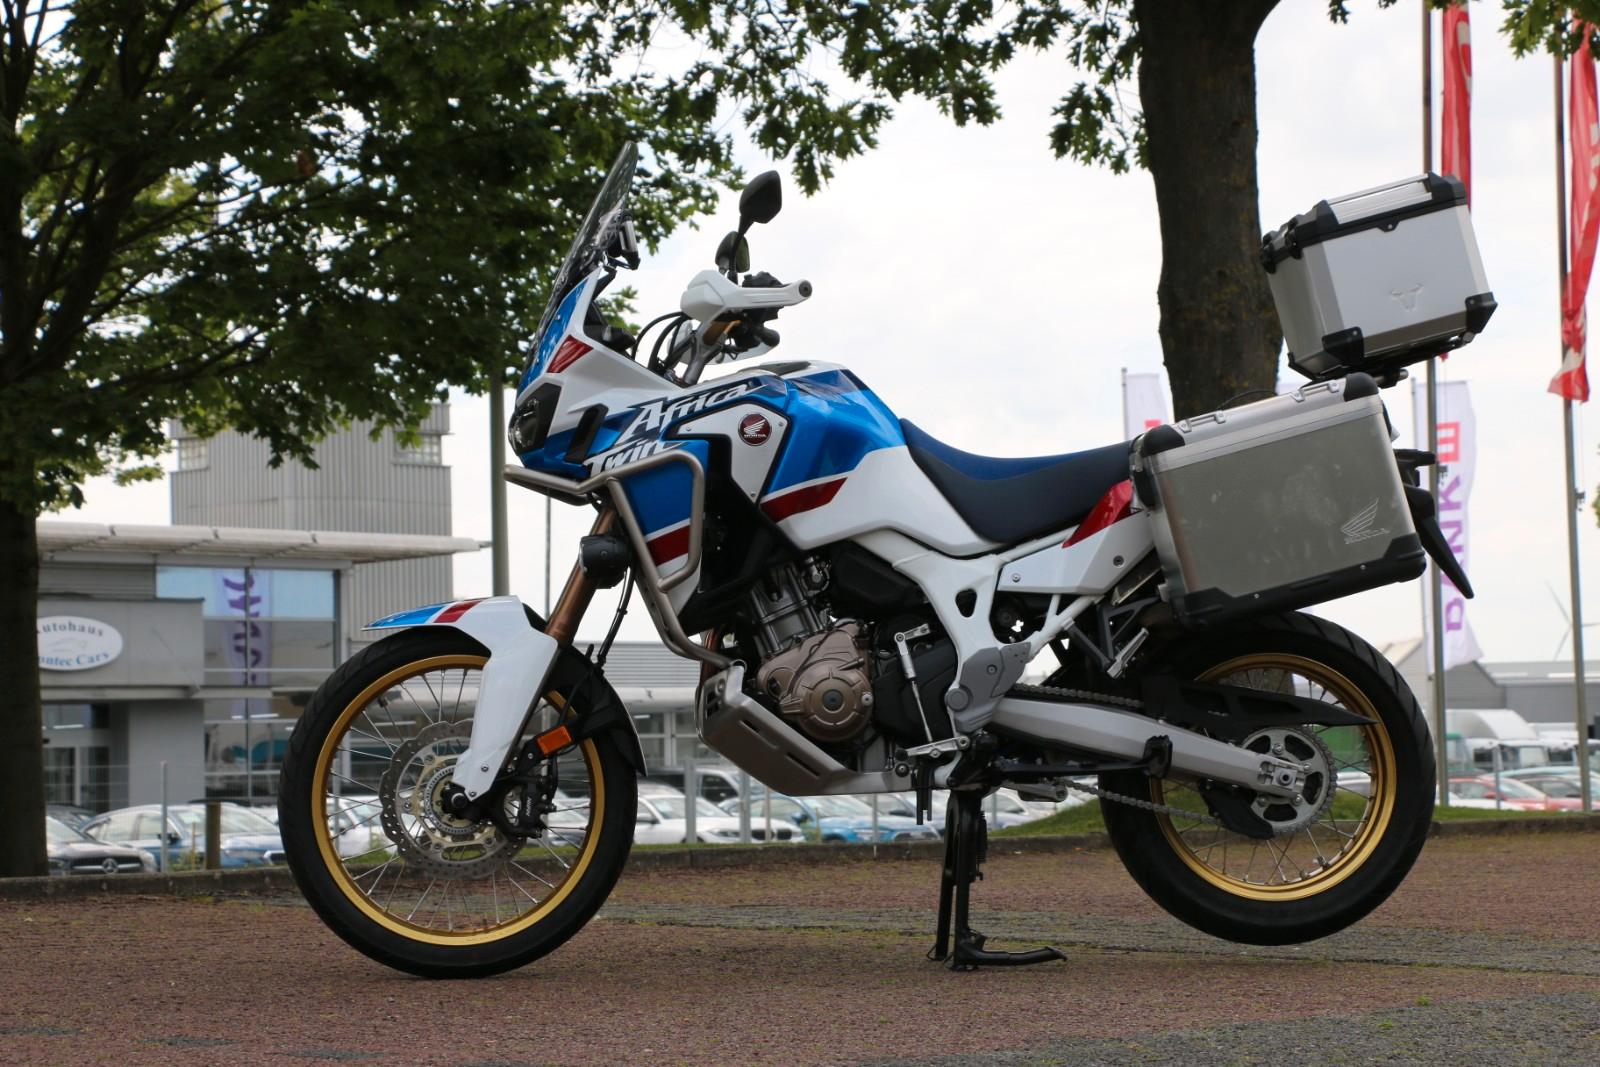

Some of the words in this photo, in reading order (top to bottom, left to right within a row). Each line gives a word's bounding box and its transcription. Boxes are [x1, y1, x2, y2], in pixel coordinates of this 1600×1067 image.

[614, 382, 768, 446] Africa
[583, 438, 686, 478] Twin
[37, 621, 103, 637] utohaus
